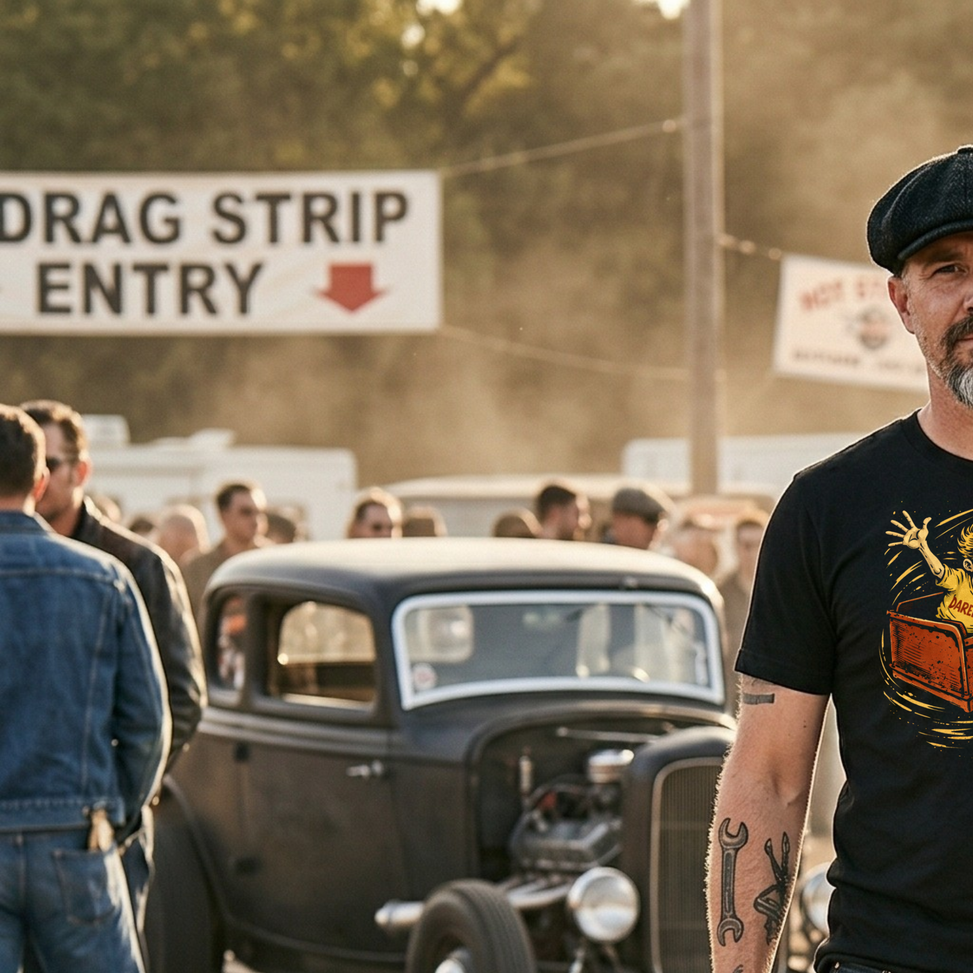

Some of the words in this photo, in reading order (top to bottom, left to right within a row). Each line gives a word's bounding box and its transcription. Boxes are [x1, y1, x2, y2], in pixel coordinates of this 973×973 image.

[0, 192, 180, 243] DRAG
[213, 191, 408, 243] STRIP
[38, 262, 263, 314] ENTRY
